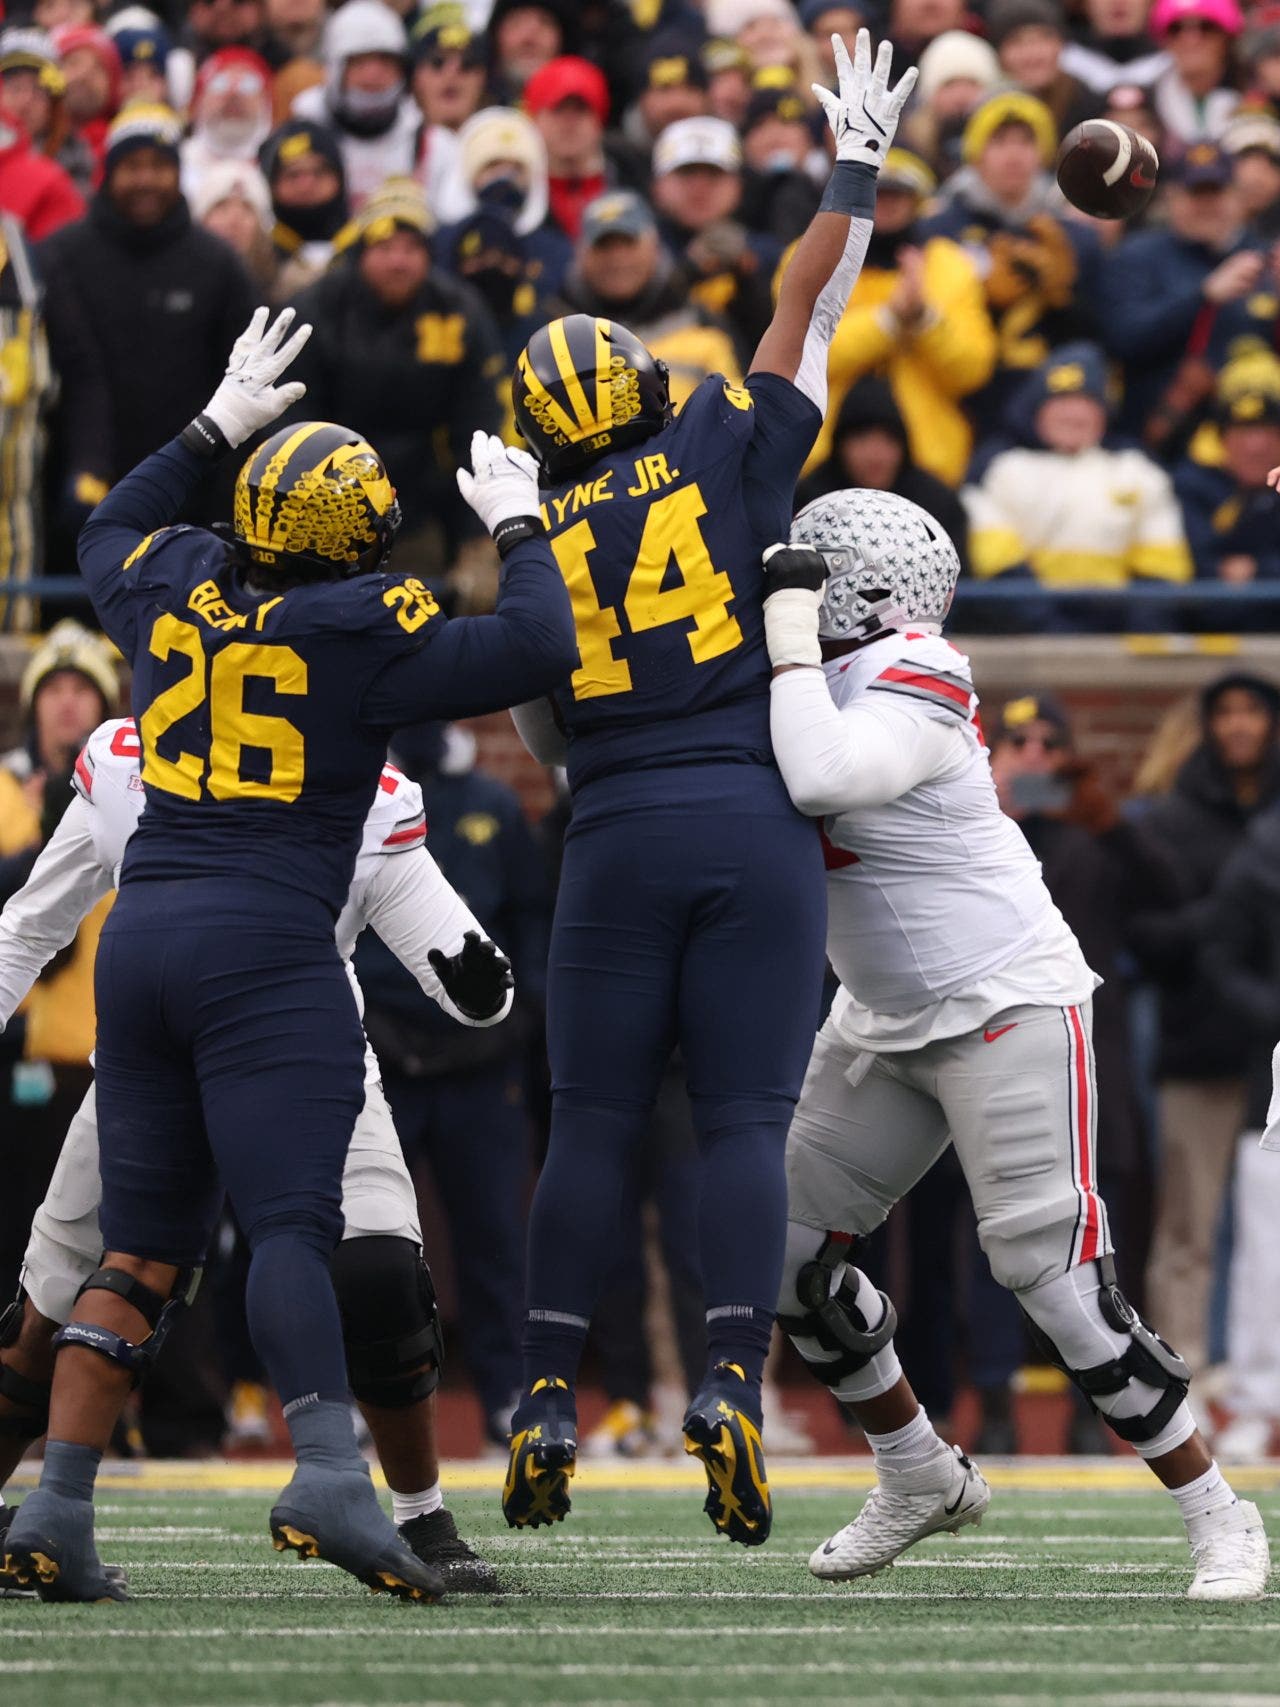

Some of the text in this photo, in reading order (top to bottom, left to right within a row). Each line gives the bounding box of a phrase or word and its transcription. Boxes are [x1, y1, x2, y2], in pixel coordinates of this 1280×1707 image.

[627, 452, 681, 498] JR.
[382, 577, 440, 634] 26
[140, 612, 308, 804] 26
[64, 1326, 105, 1342] DONJOY
